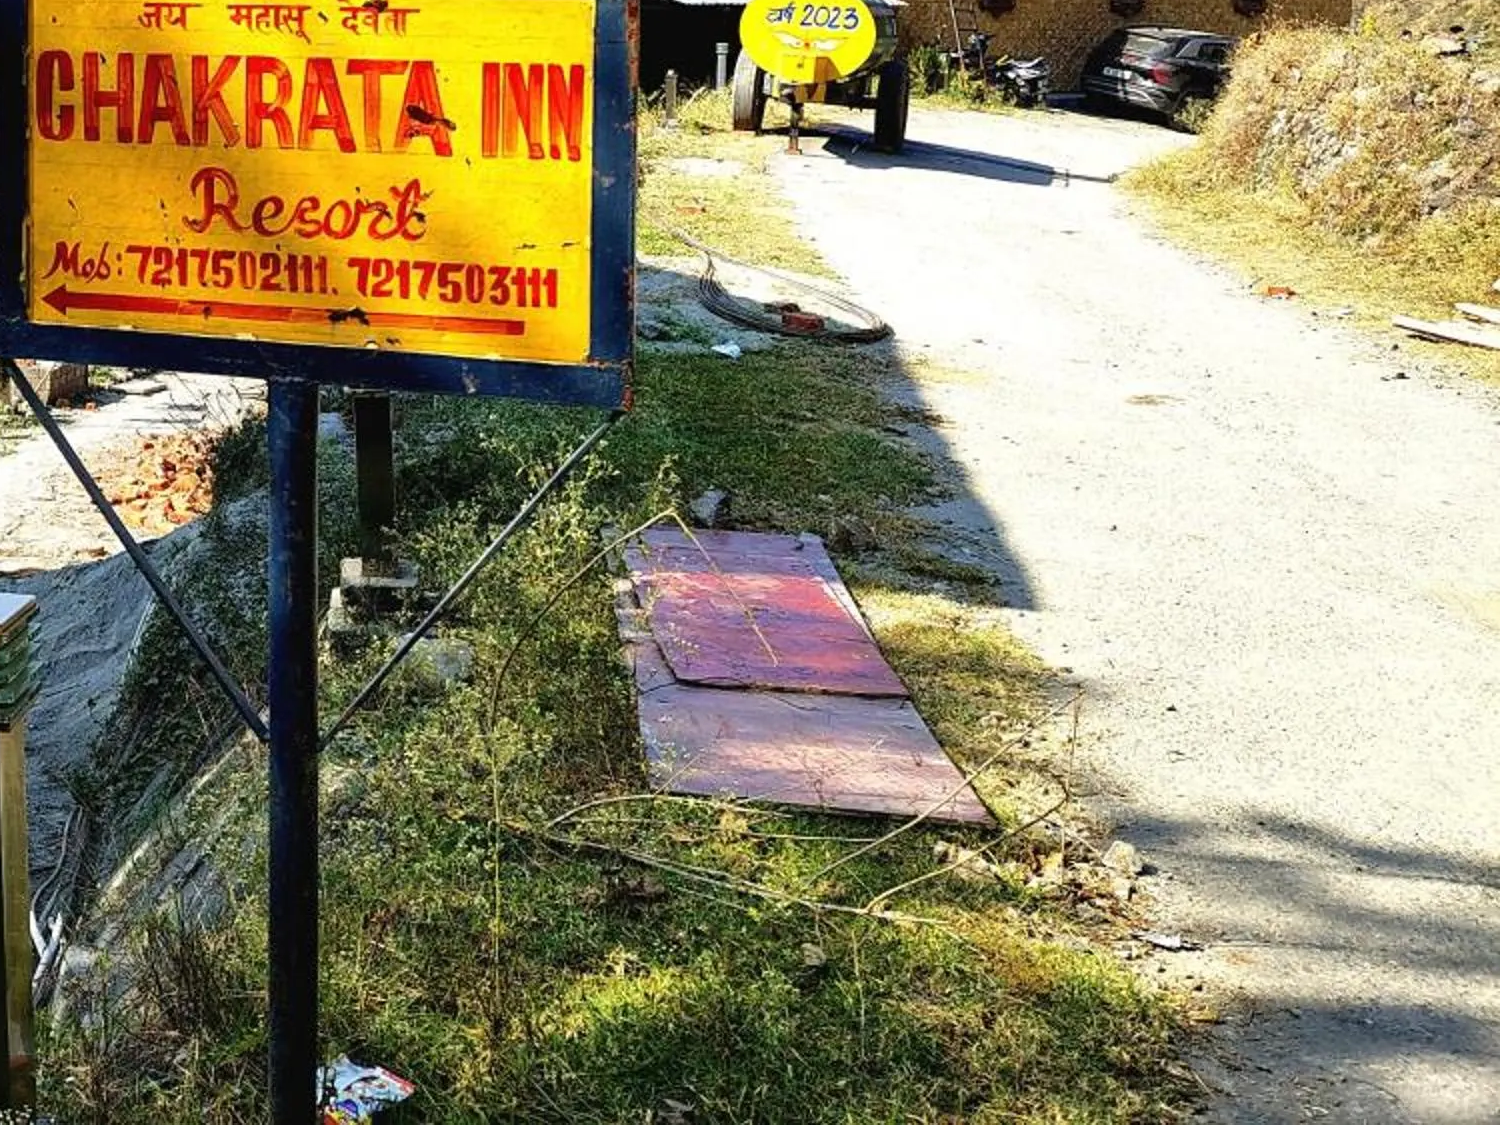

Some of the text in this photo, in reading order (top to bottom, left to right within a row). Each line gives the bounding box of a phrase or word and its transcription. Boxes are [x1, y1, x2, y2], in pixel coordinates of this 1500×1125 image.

[138, 2, 202, 30] जय
[227, 4, 312, 44] महासू
[799, 3, 860, 30] 2023
[35, 49, 586, 163] CHAKRATA INN
[182, 166, 429, 242] Resort
[347, 257, 559, 309] 7217503111
